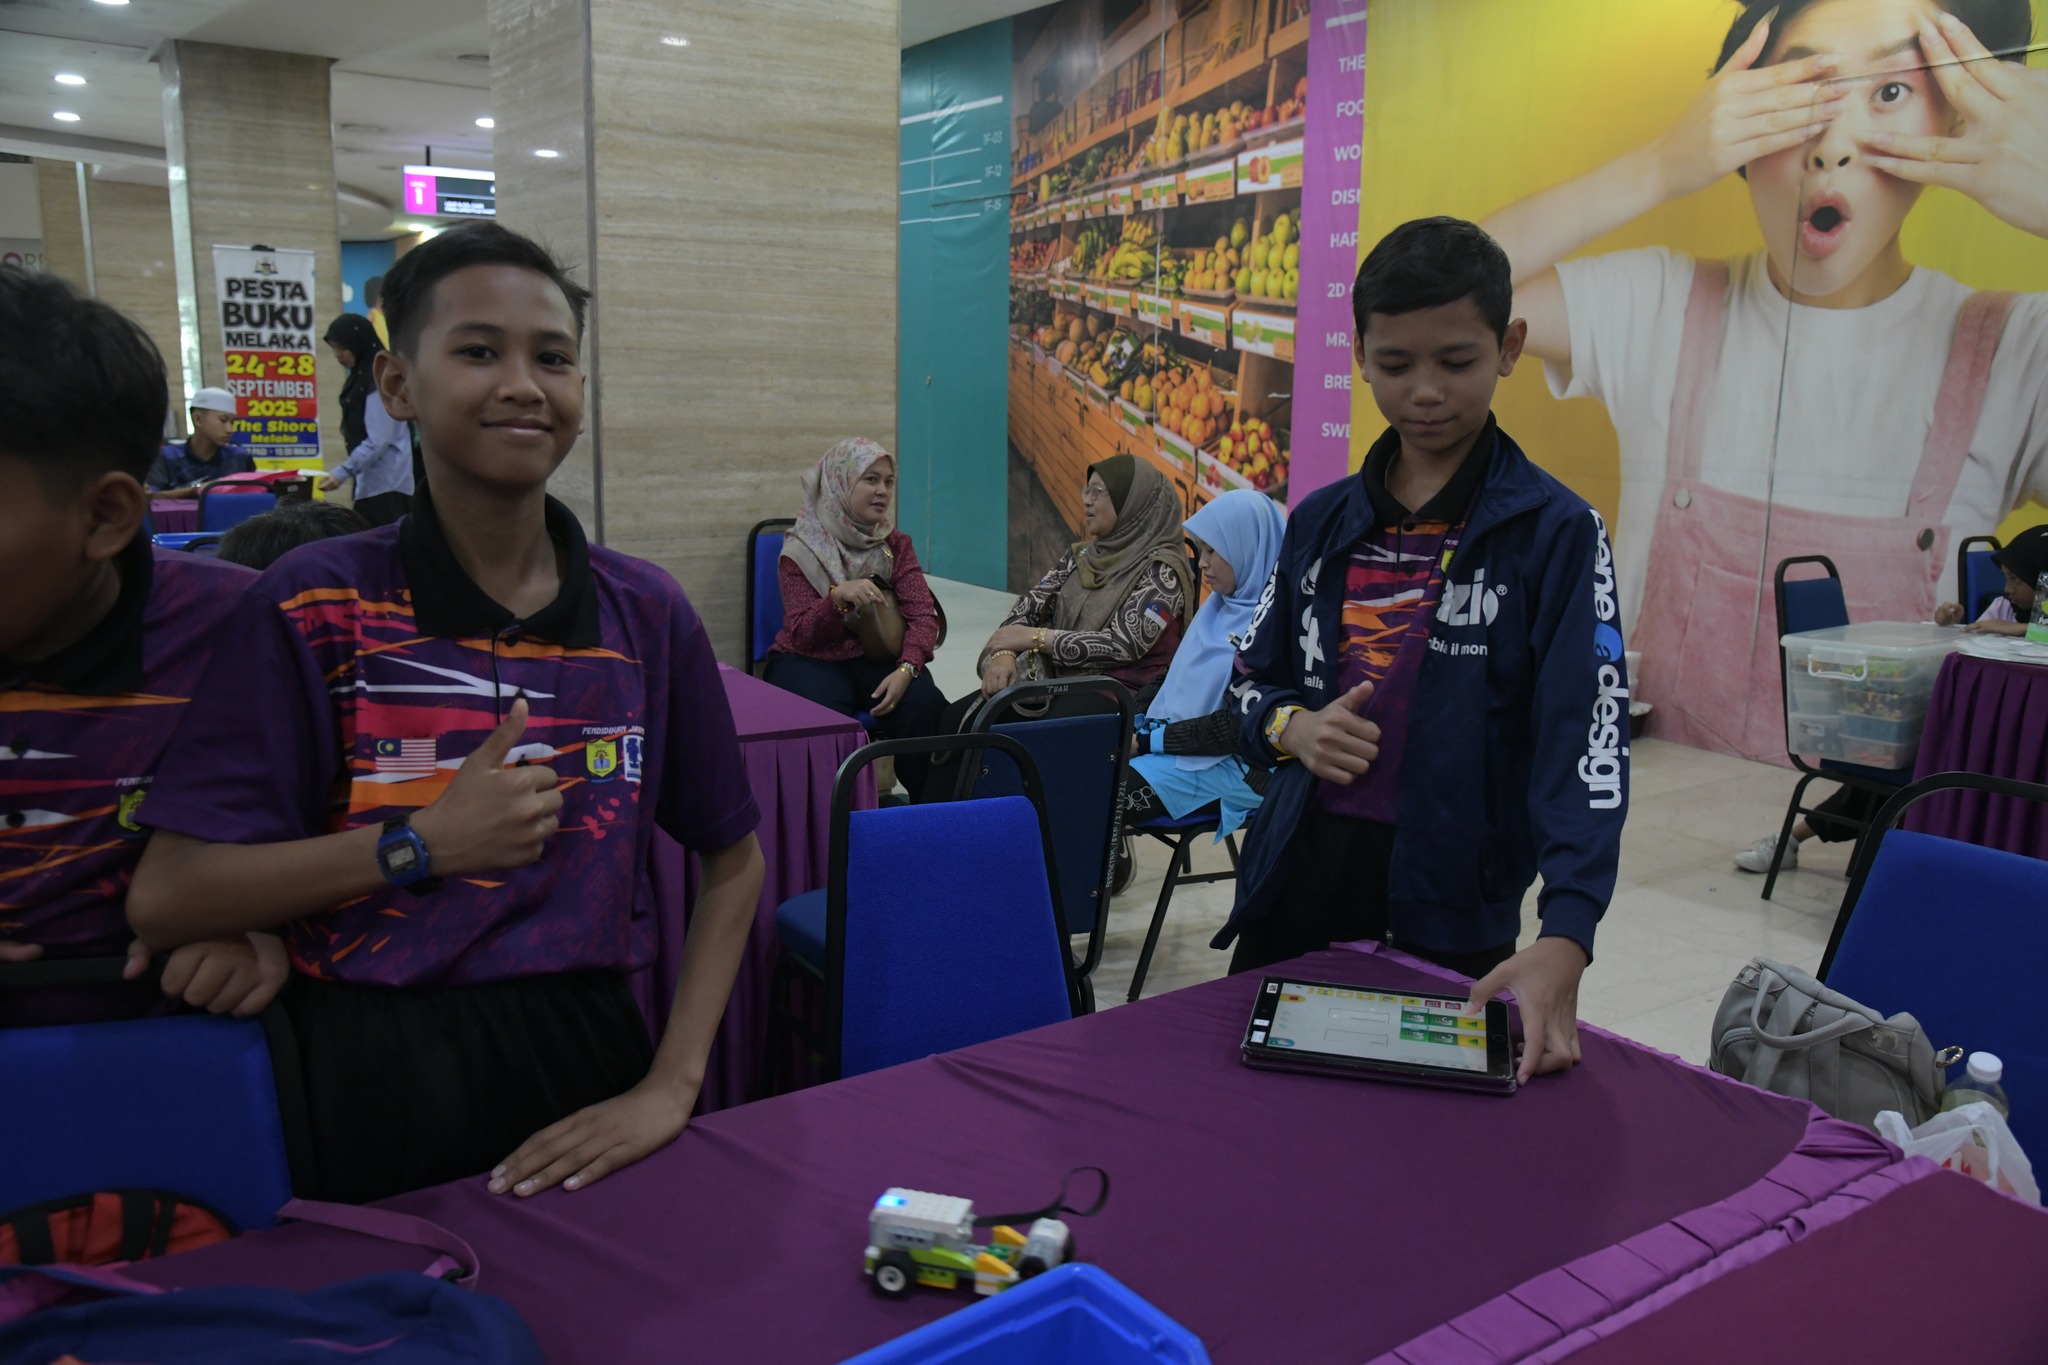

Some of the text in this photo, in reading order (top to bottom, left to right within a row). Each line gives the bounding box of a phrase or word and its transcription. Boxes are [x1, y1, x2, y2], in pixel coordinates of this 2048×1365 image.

[226, 280, 307, 300] PESTA
[1327, 282, 1345, 298] 2D
[223, 302, 312, 330] BUKU
[226, 332, 312, 349] MELAKA
[1326, 332, 1350, 347] MR.
[226, 353, 315, 378] 24-28
[227, 379, 314, 399] SEPTEMBER
[246, 399, 298, 417] 2025
[266, 419, 317, 433] Shore
[250, 433, 298, 443] Melaka
[581, 725, 627, 735] PENDIDIKAN
[1577, 664, 1629, 809] design
